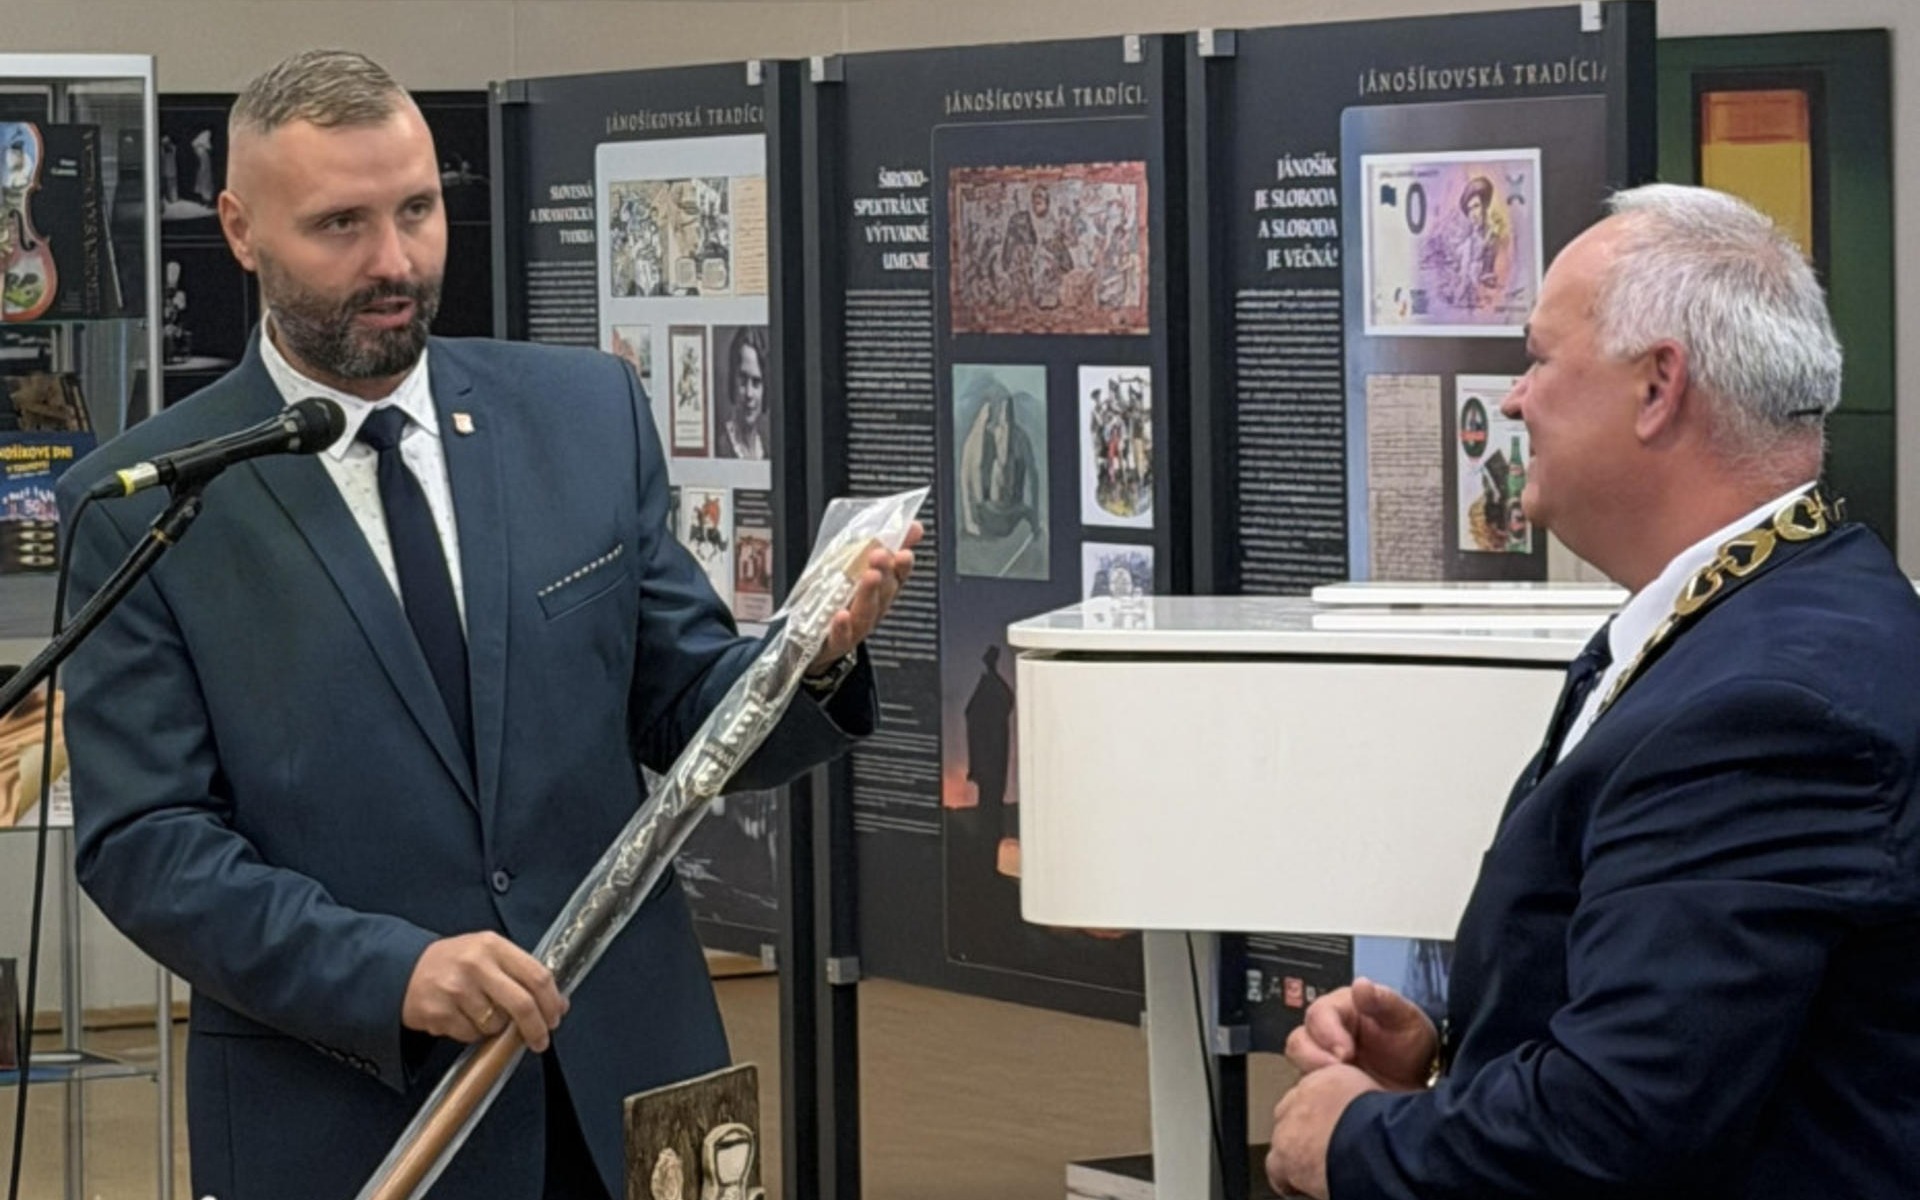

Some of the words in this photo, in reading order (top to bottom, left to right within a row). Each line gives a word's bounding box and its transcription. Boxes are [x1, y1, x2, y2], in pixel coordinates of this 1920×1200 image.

[1357, 62, 1505, 96] JÁNOŠÍKOVSKÁ
[945, 85, 1065, 114] JÁNOŠÍKOVSKÁ
[1073, 82, 1146, 106] TRADÍCI
[707, 103, 764, 126] TRADÍCI
[1277, 152, 1337, 181] JÁNOŠÍK
[853, 193, 929, 216] SPEKTRÁLNE
[1254, 189, 1269, 211] JE
[1271, 188, 1338, 208] SLOBODA
[865, 219, 930, 243] VÝTVARNÉ
[1258, 220, 1268, 238] A
[1271, 220, 1338, 238] SLOBODA
[883, 252, 930, 270] UMENIE
[1266, 249, 1281, 271] JE
[1284, 245, 1339, 267] VEČNÁ!
